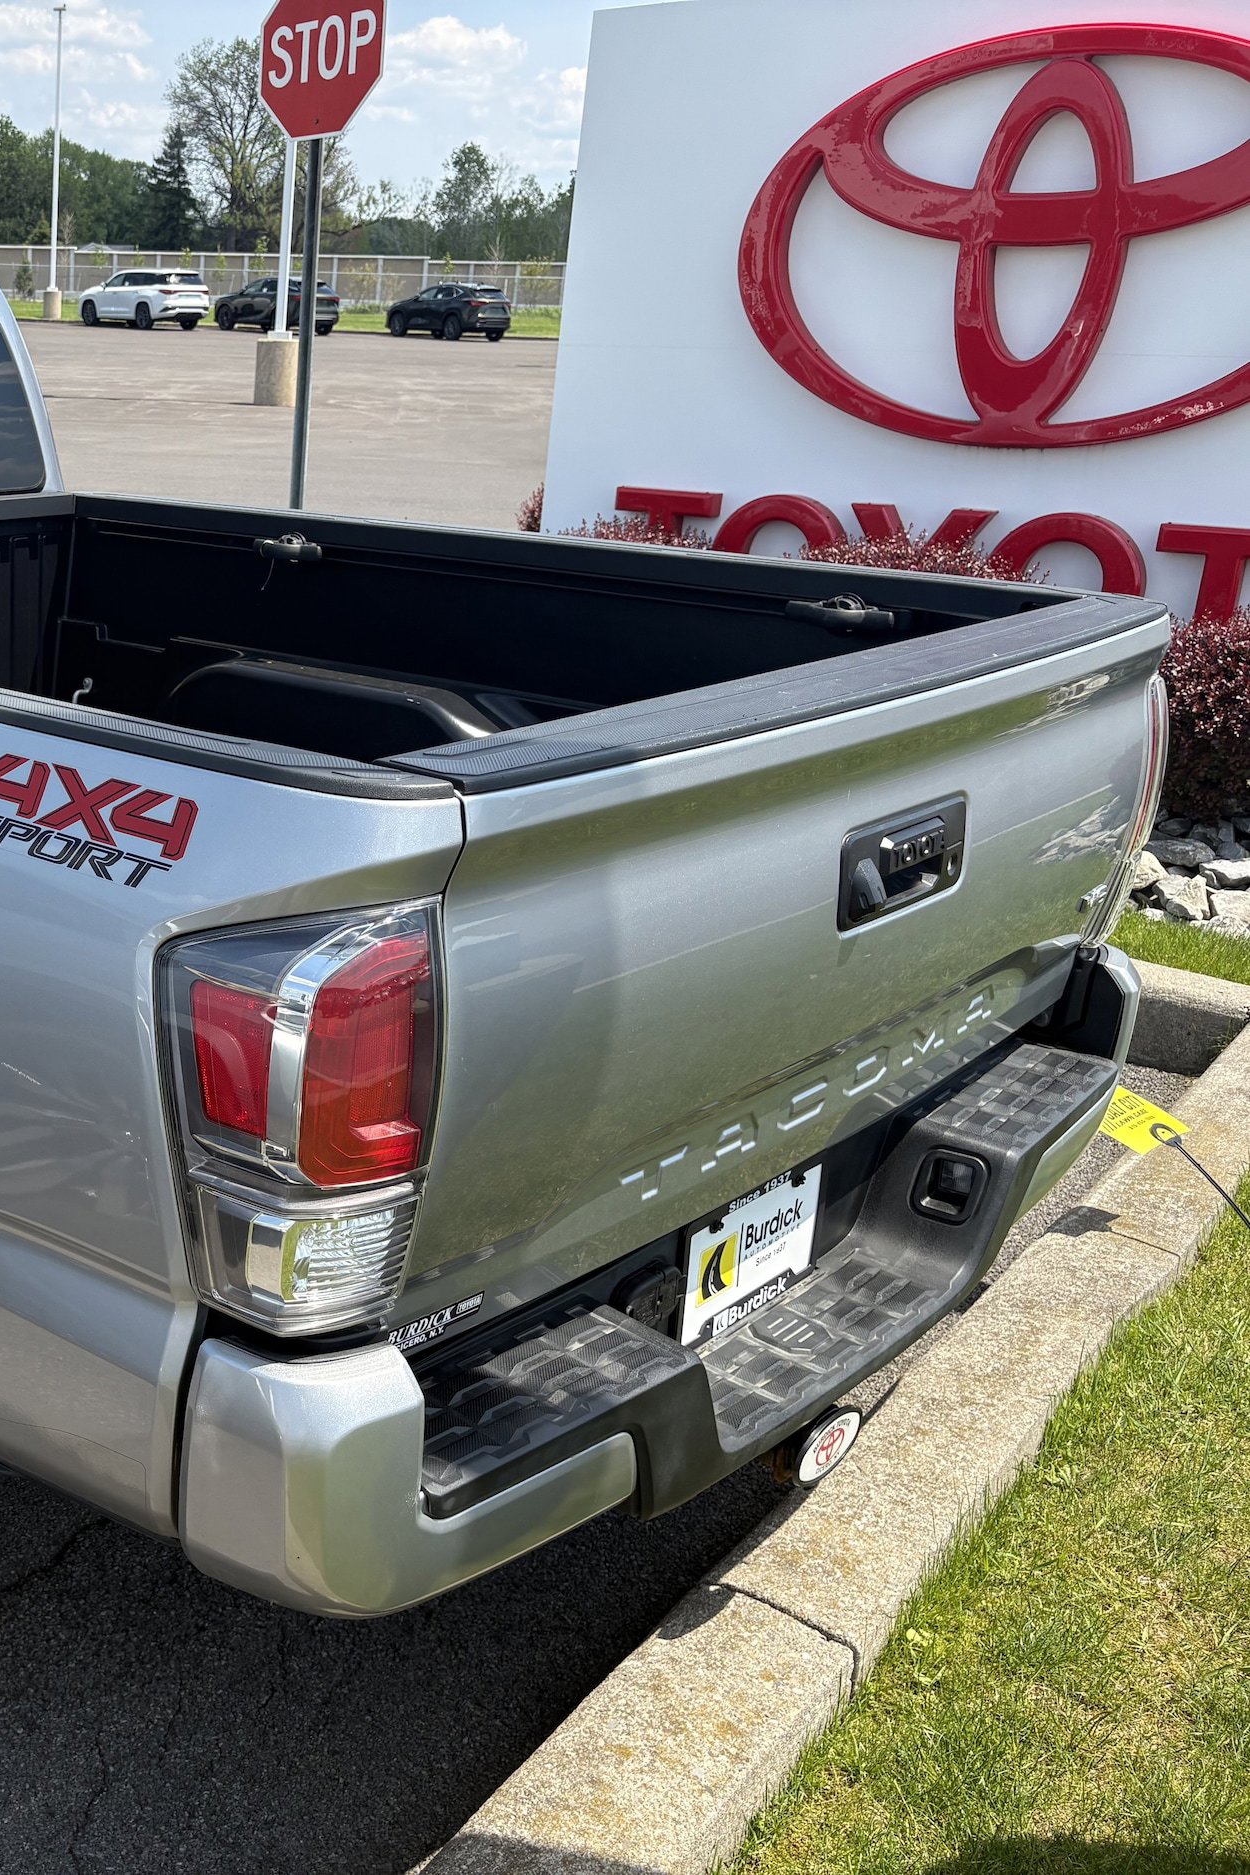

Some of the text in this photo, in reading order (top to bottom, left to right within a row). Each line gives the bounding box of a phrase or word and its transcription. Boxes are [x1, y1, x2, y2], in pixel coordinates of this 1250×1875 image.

[268, 9, 377, 88] STOP
[619, 984, 995, 1201] TACOMA
[728, 1170, 792, 1214] Since 1937
[744, 1197, 804, 1252] Burdick
[755, 1251, 773, 1267] Since
[388, 1304, 456, 1345] BURDICK
[728, 1275, 788, 1327] Burdick
[429, 1325, 445, 1339] N.Y.
